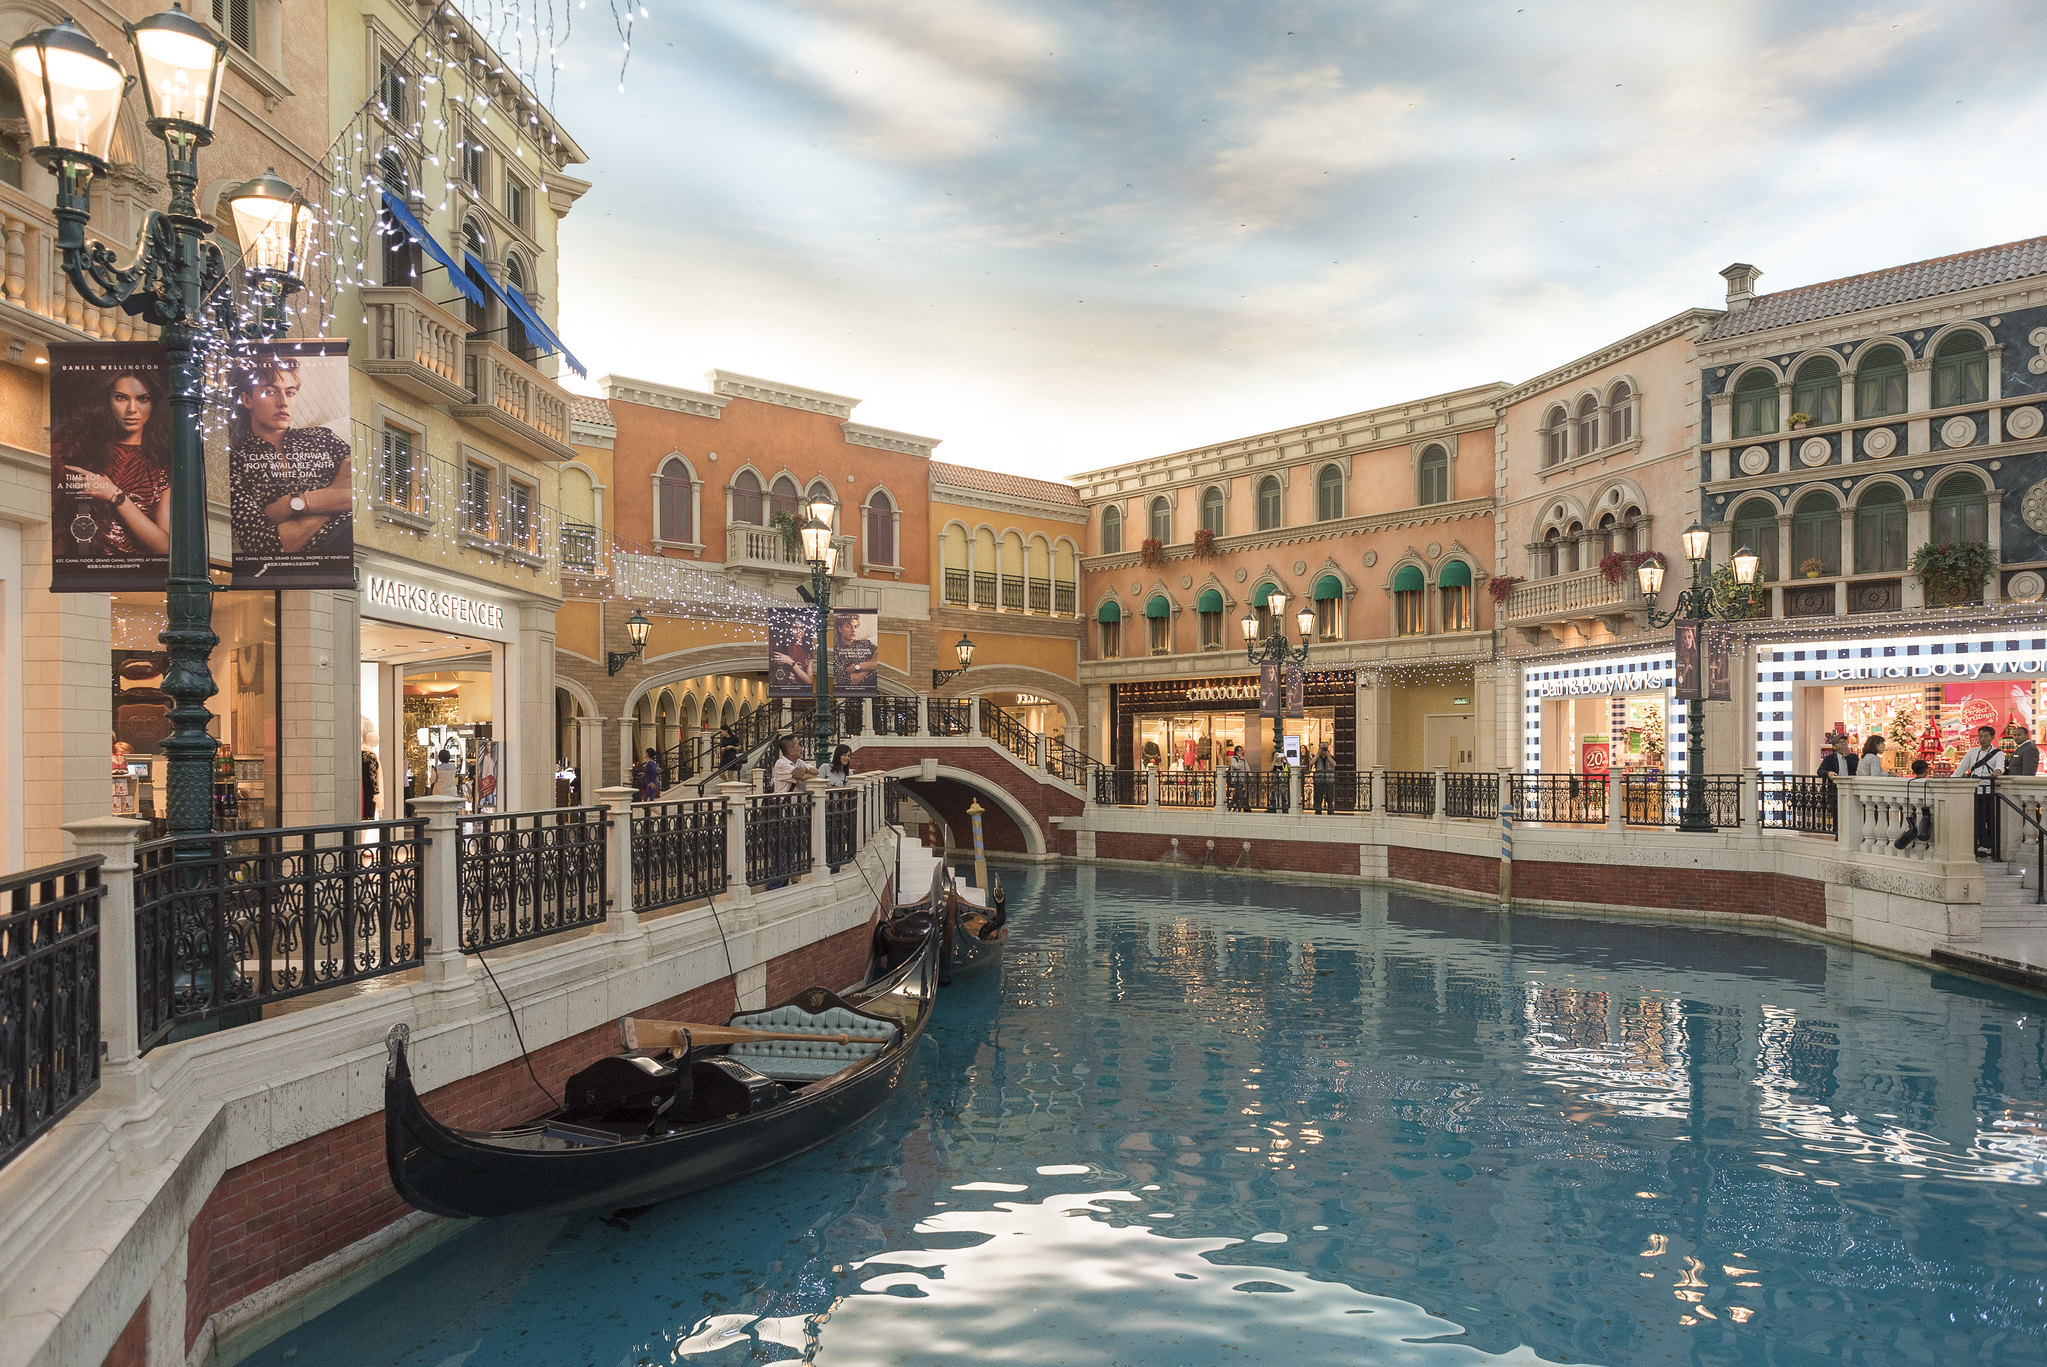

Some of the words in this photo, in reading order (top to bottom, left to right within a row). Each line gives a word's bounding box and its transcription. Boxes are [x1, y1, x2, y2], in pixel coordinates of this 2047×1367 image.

[249, 453, 283, 461] CLASSIC
[285, 452, 331, 460] CORNWALL
[246, 462, 268, 470] NOW
[270, 461, 311, 469] AVAILABLE
[1587, 752, 1603, 767] 20
